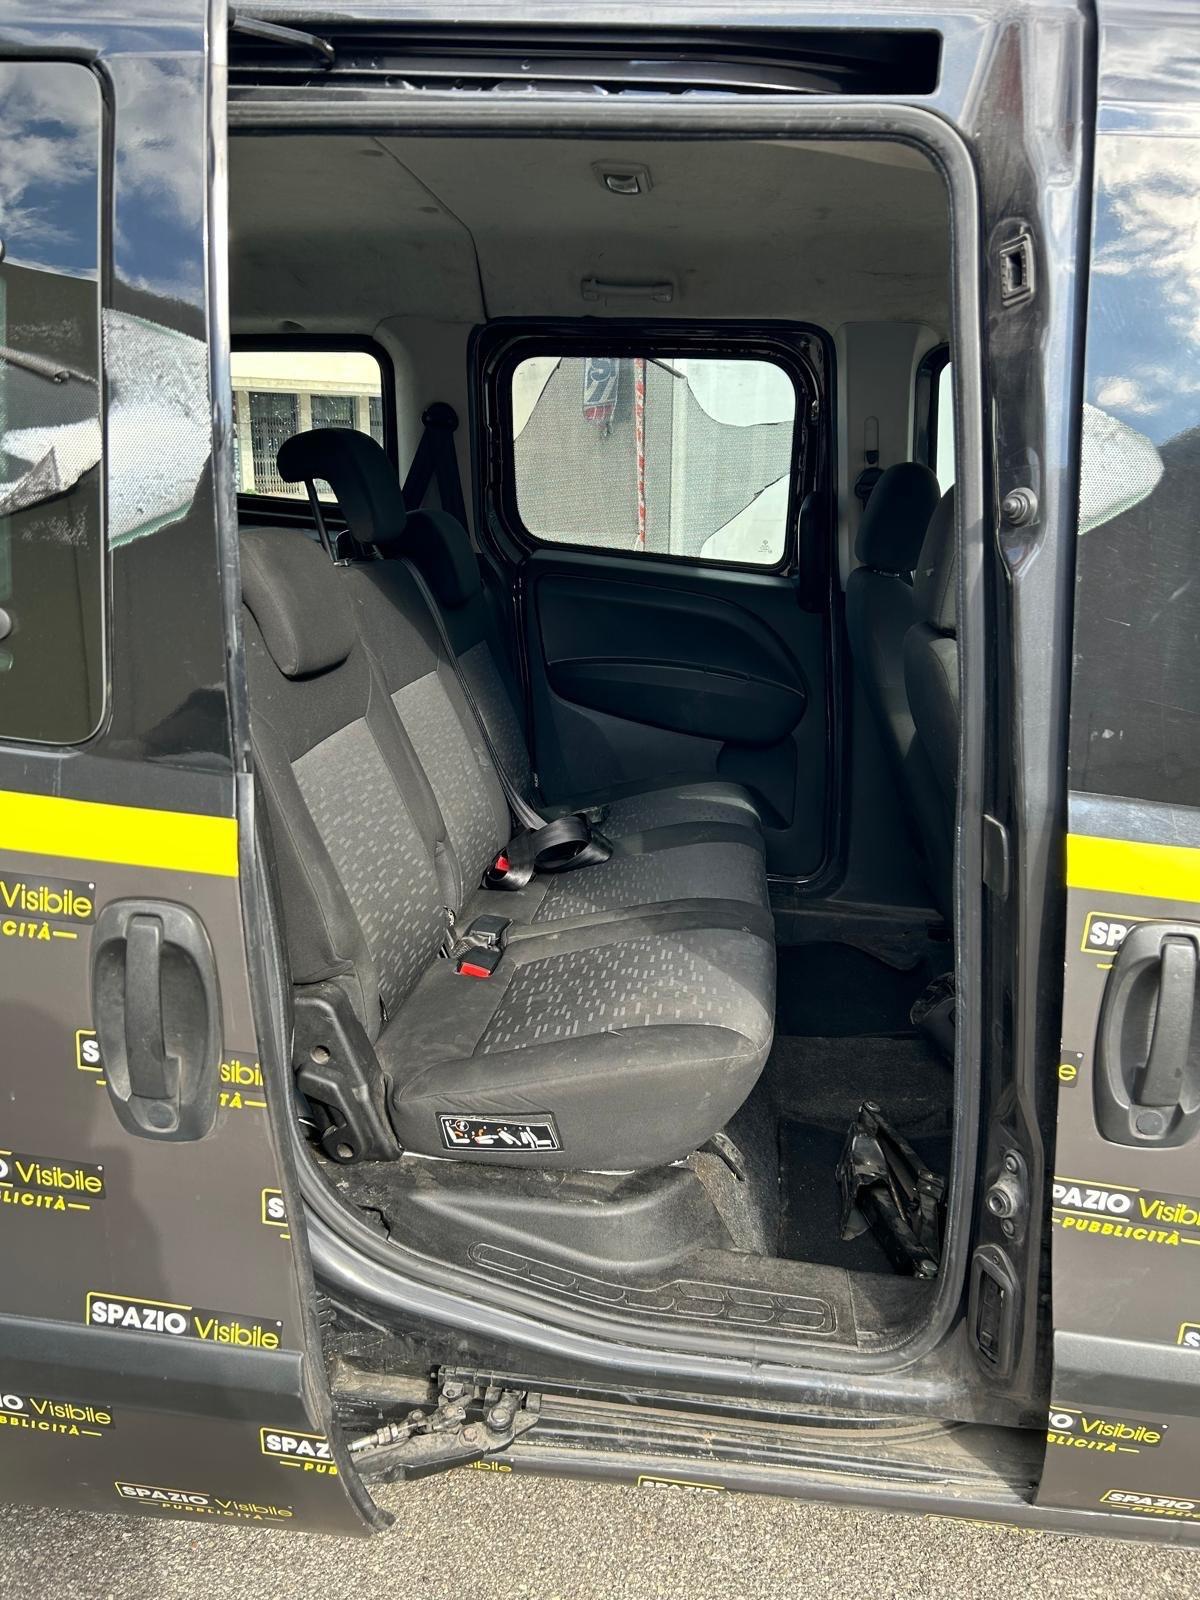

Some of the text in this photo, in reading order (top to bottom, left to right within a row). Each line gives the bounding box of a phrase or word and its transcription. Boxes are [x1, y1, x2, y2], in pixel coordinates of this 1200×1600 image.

[0, 880, 93, 918] Visibile
[0, 920, 51, 941] CITÀ
[1089, 921, 1136, 947] SP
[15, 1160, 103, 1193] Visibile
[0, 1190, 66, 1211] LICITÀ
[268, 1197, 287, 1218] S
[1061, 1216, 1180, 1246] PUBBLICITÀ
[91, 1301, 280, 1350] SPAZIO Visibile
[29, 1397, 112, 1425] Visibile
[1081, 1417, 1161, 1444] Visibile
[266, 1434, 333, 1459] SPAZ
[121, 1485, 209, 1506] SPAZIO
[1108, 1492, 1196, 1510] SPAZIO
